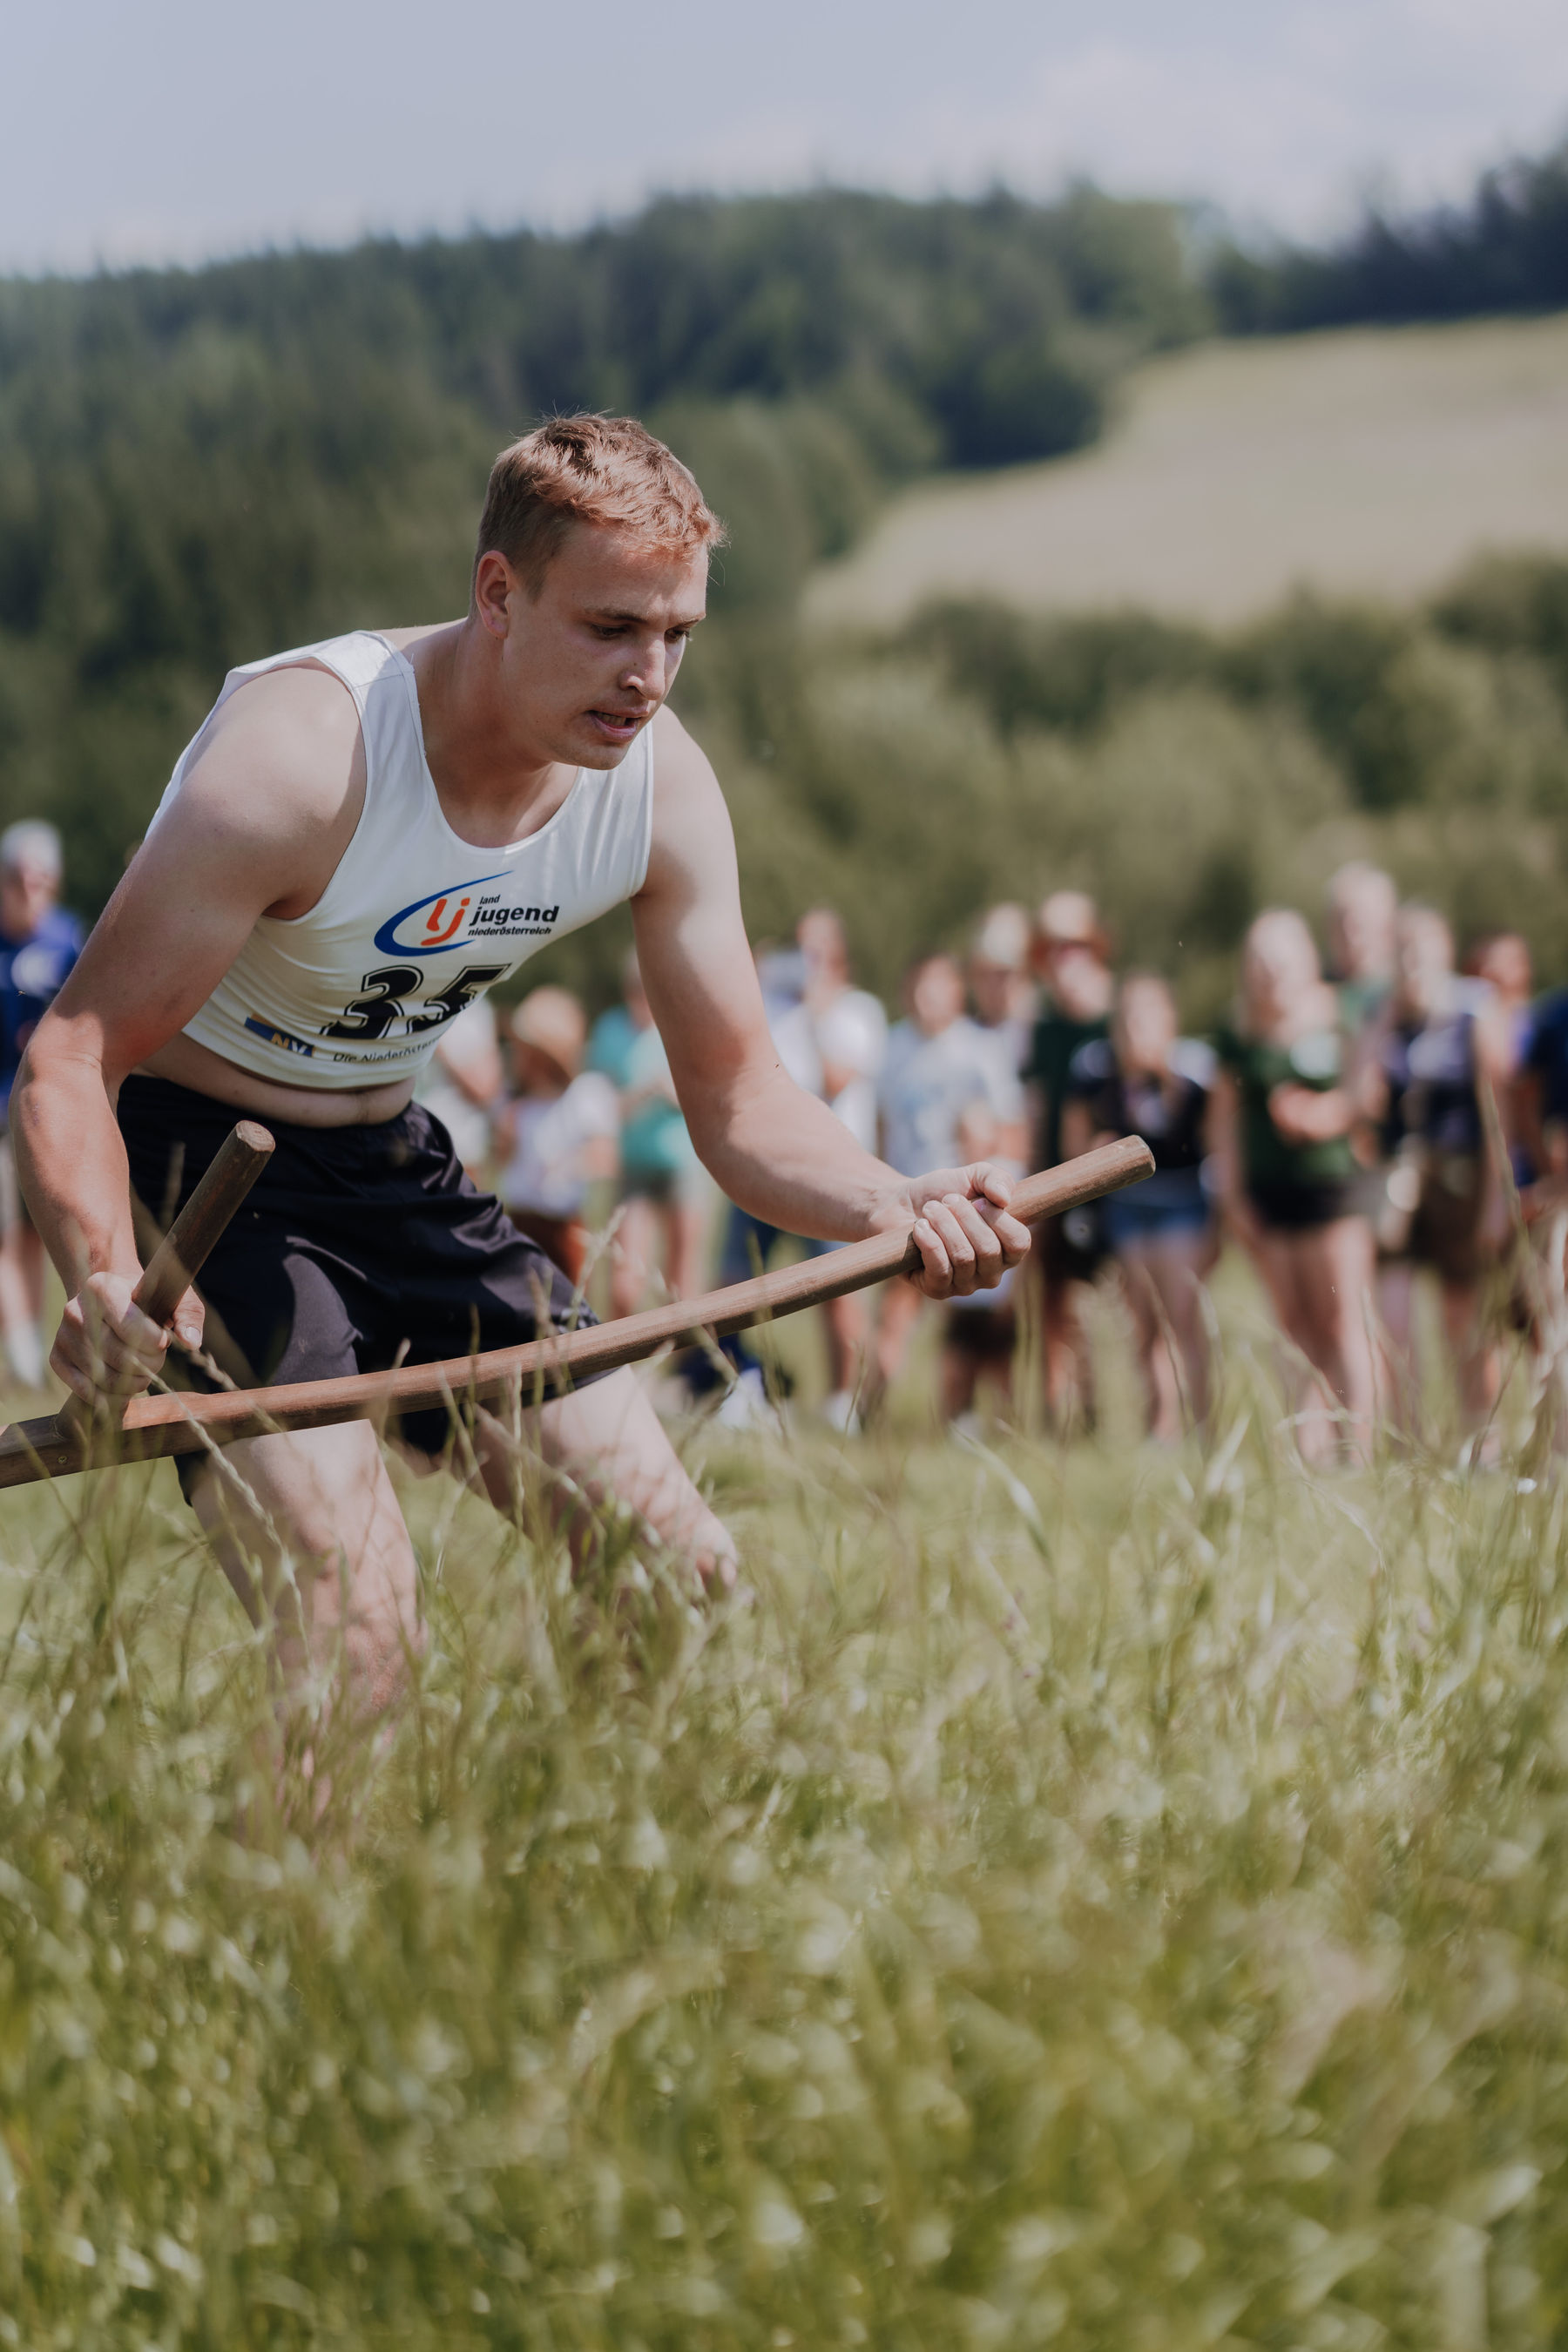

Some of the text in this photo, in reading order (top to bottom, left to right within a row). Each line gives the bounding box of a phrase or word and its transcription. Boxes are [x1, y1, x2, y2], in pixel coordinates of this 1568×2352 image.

[480, 895, 501, 904] land
[469, 906, 559, 926] jugend
[468, 927, 551, 936] niederösterreich
[319, 963, 512, 1039] 35
